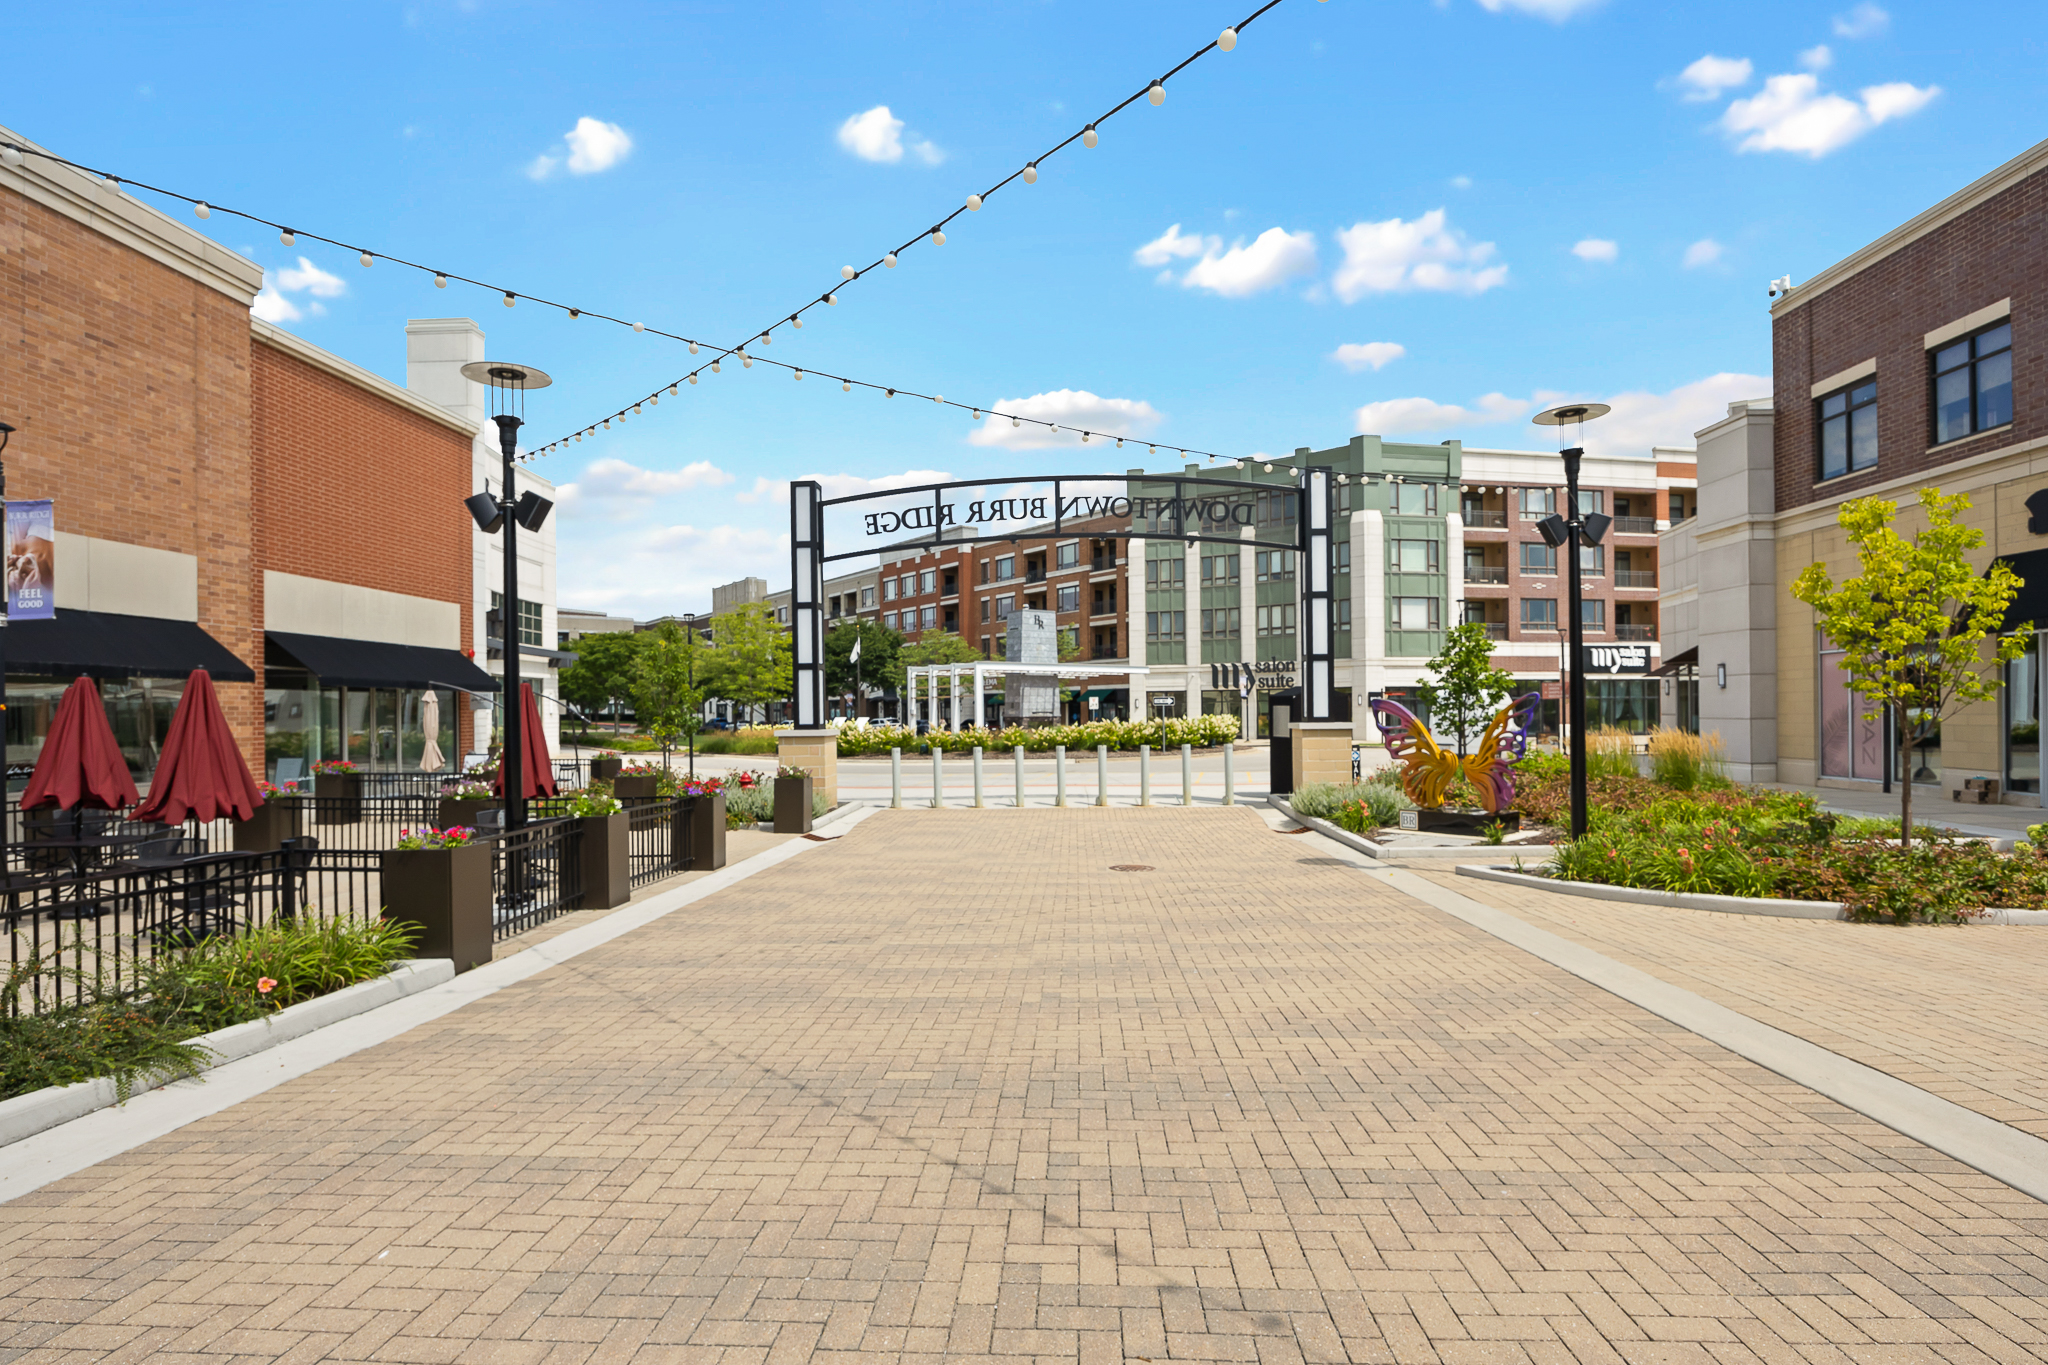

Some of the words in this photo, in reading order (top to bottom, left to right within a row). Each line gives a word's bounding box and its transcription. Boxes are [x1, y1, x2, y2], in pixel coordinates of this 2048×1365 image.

[19, 588, 43, 599] FEEL
[18, 600, 44, 609] GOOD
[1255, 656, 1296, 673] salon
[1590, 647, 1621, 674] my
[1258, 673, 1295, 688] suite
[1402, 815, 1416, 826] BR
